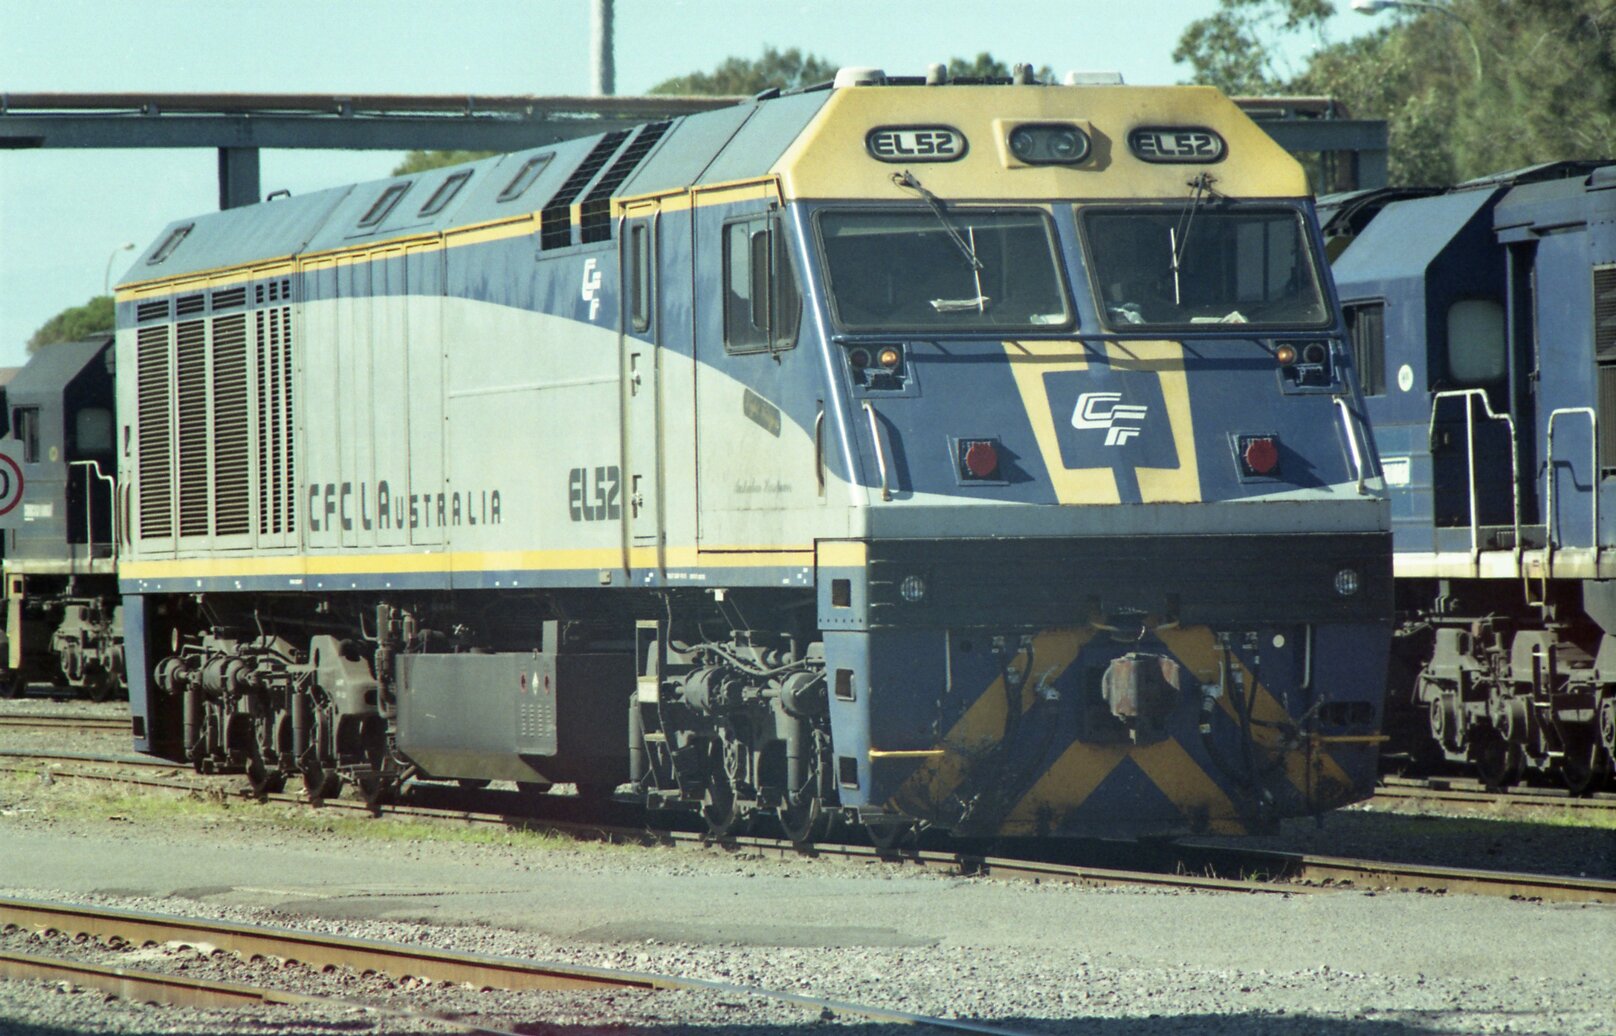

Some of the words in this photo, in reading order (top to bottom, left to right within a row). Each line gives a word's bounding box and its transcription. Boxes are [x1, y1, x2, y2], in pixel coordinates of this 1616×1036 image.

[873, 131, 954, 155] EL52
[1138, 132, 1212, 156] EL52
[568, 465, 621, 522] EL52
